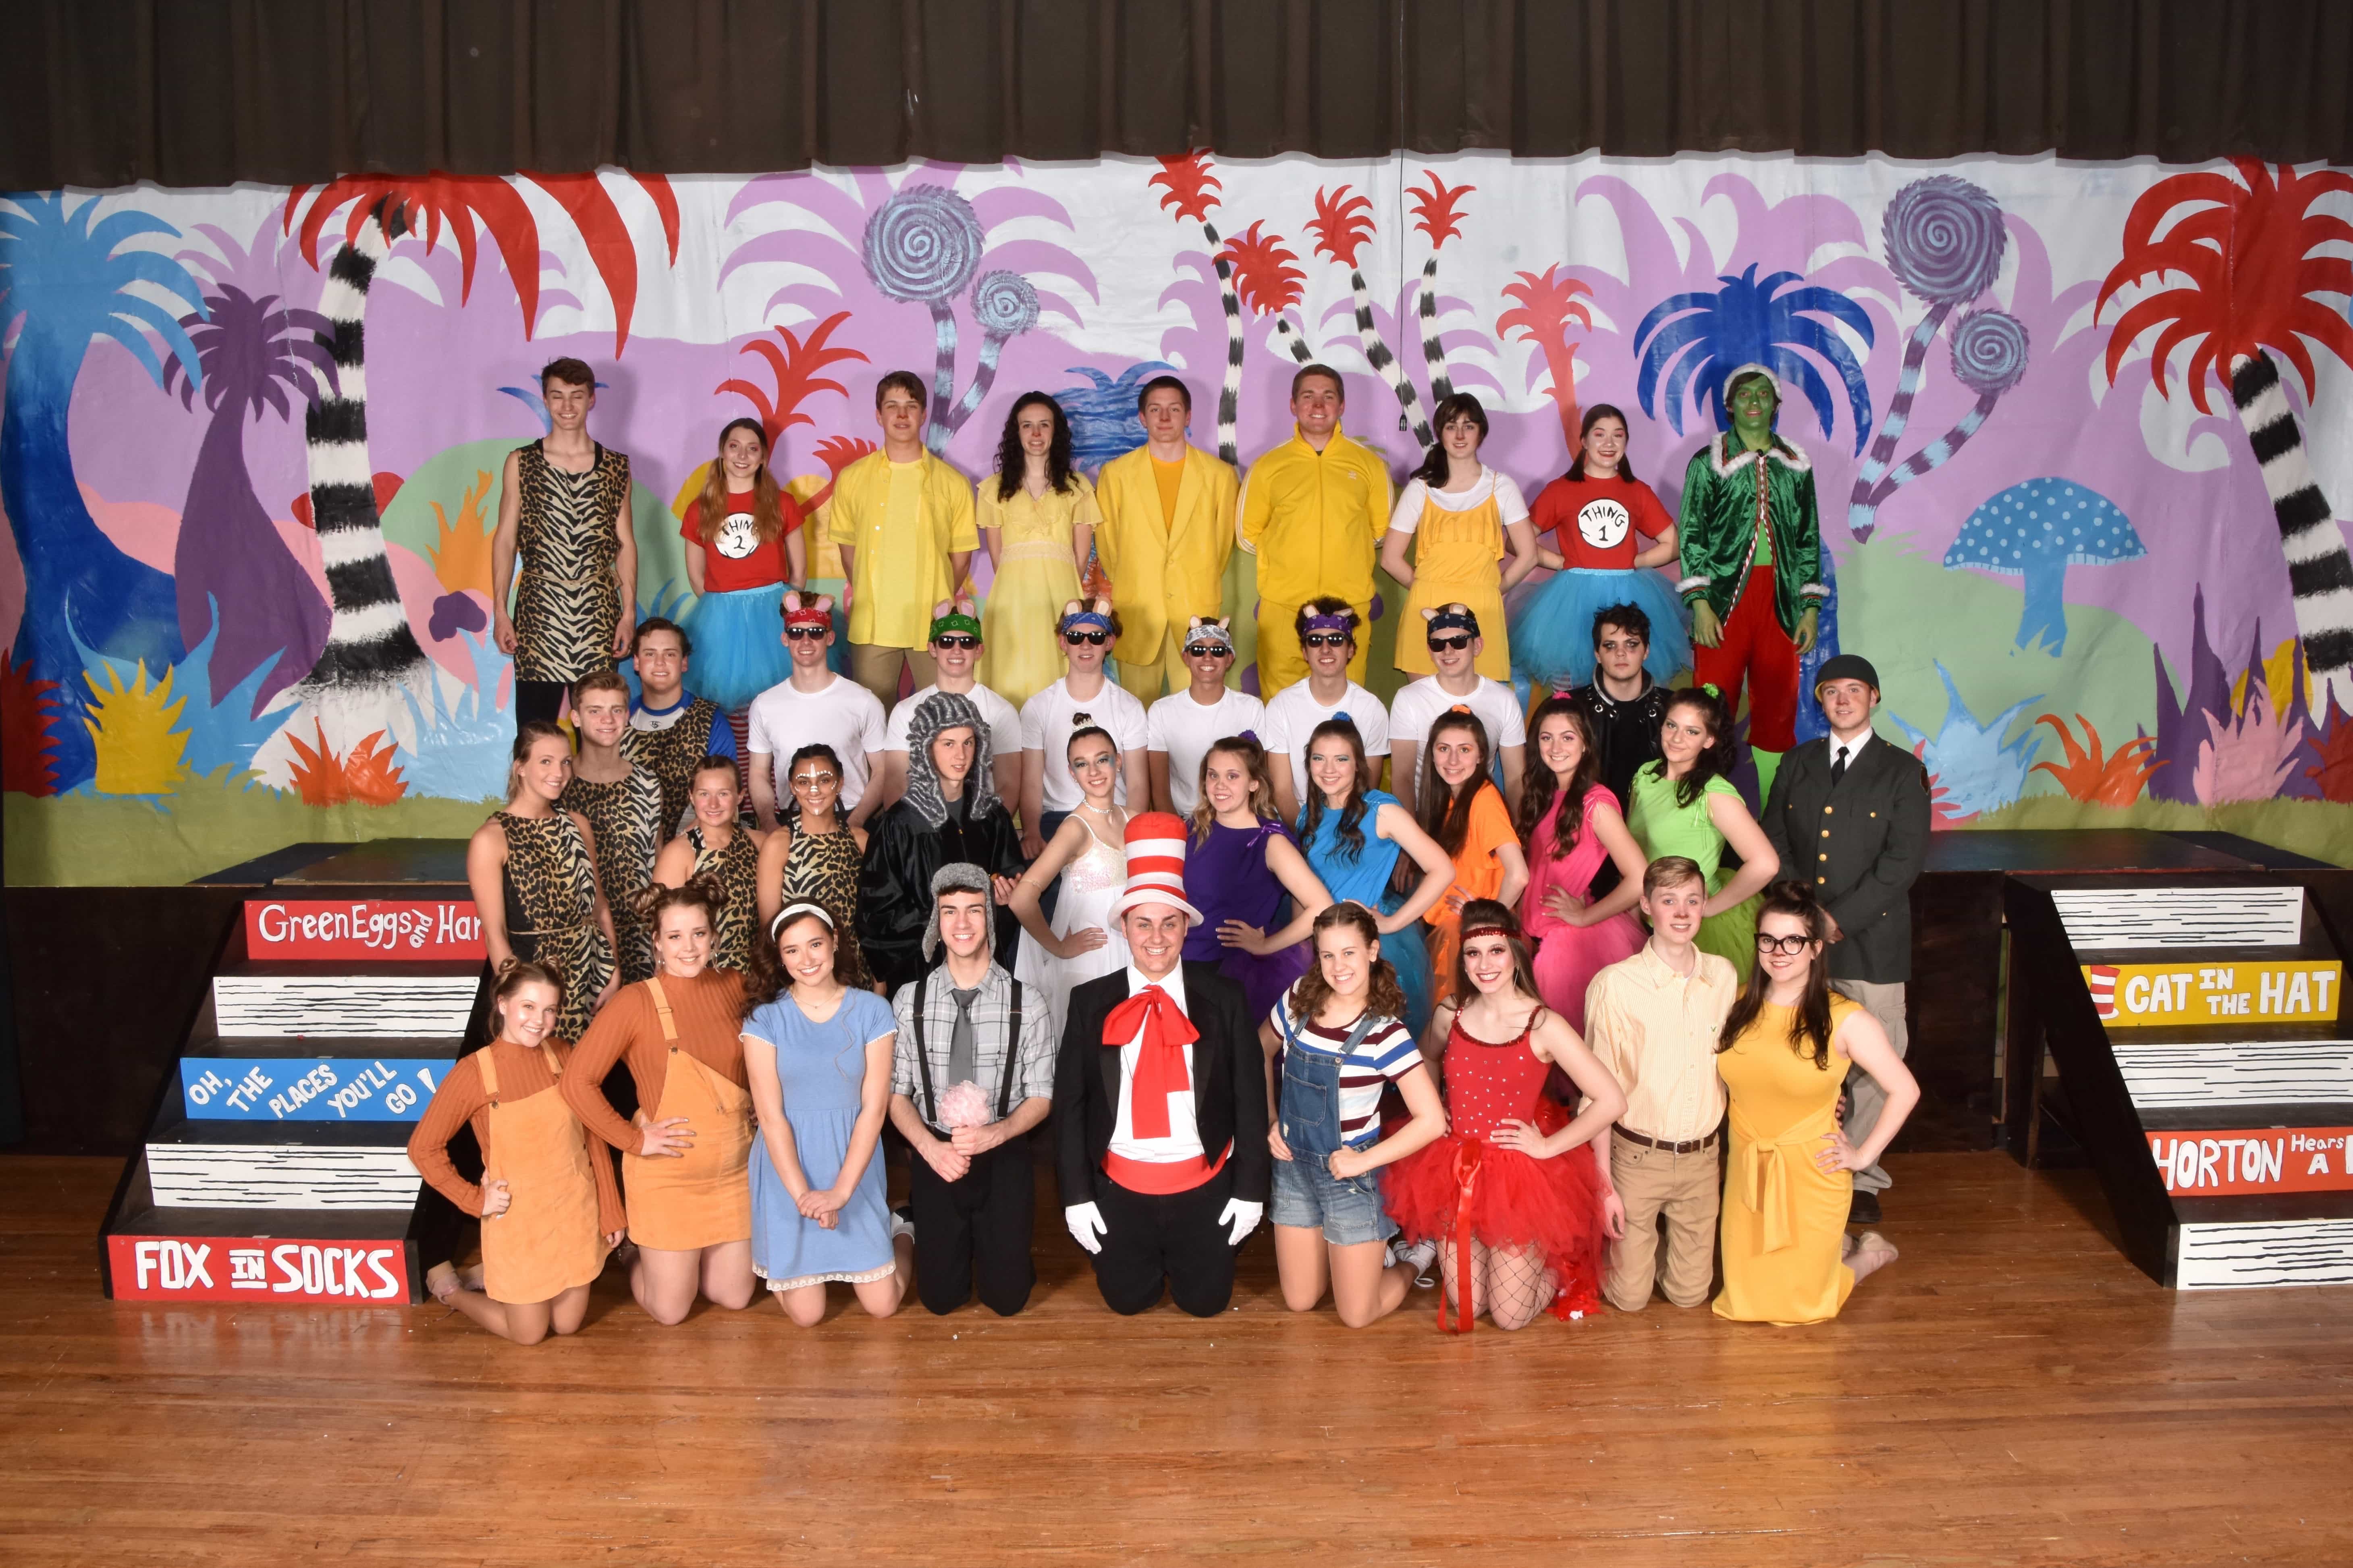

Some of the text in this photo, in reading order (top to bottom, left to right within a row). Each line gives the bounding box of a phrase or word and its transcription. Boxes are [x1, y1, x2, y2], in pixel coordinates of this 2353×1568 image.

[1580, 506, 1626, 527] THING
[733, 535, 746, 550] 2
[1598, 525, 1609, 541] 1
[409, 909, 433, 948] and
[2125, 968, 2336, 1015] CAT IN THE HAT
[189, 1070, 232, 1105] OH,
[226, 1066, 273, 1112] THE
[268, 1064, 338, 1119] PLACES
[327, 1060, 398, 1118] YOU'LL
[2291, 1134, 2345, 1153] Hears
[2152, 1138, 2284, 1191] HORTON
[2307, 1153, 2330, 1175] A
[135, 1240, 399, 1299] FOX IN SOCKS
